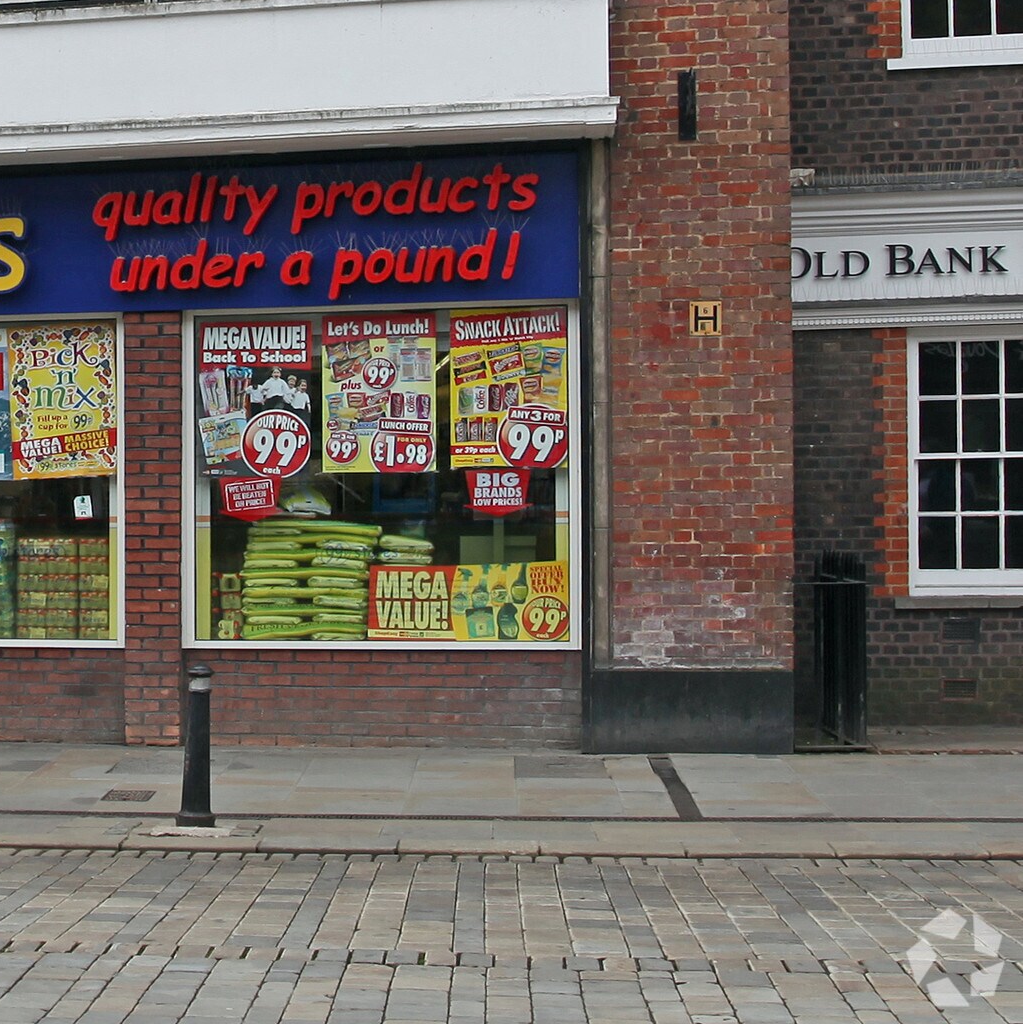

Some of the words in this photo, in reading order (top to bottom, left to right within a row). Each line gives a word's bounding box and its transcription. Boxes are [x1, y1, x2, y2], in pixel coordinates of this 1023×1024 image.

[290, 162, 539, 234] products
[110, 238, 265, 291] under
[280, 250, 314, 285] a
[885, 243, 1009, 277] BANK
[328, 321, 360, 337] Let's
[363, 320, 382, 336] Do
[385, 318, 430, 336] Lunch!
[455, 319, 502, 341] SNACK
[503, 312, 561, 336] ATTACK!
[694, 305, 718, 333] H
[203, 326, 251, 351] MEGA
[251, 324, 307, 350] VALUE!
[203, 351, 237, 364] Back
[241, 351, 257, 364] To
[260, 350, 307, 363] School
[373, 345, 385, 353] or
[340, 380, 362, 392] plus
[34, 386, 97, 409] mix
[257, 415, 275, 429] OUR
[275, 414, 300, 432] PRICE
[381, 420, 405, 430] LUNCH
[406, 421, 429, 431] OFFER
[510, 410, 531, 419] ANY
[530, 410, 542, 422] 3
[543, 412, 561, 423] FOR
[38, 423, 54, 431] cup
[20, 437, 61, 452] MEGA
[64, 430, 110, 444] MASSIVE
[21, 445, 63, 459] VALUE!
[64, 438, 110, 452] CHOICE!
[479, 446, 496, 454] each
[374, 435, 428, 467] £1.98
[262, 466, 281, 475] each
[476, 472, 520, 487] BIG
[240, 484, 255, 492] WILL
[474, 487, 522, 498] BRANDS
[473, 498, 492, 506] LOW
[492, 497, 523, 506] PRICES!
[375, 570, 449, 600] MEGA
[532, 585, 564, 593] NOW!
[375, 600, 449, 631] VALUE!
